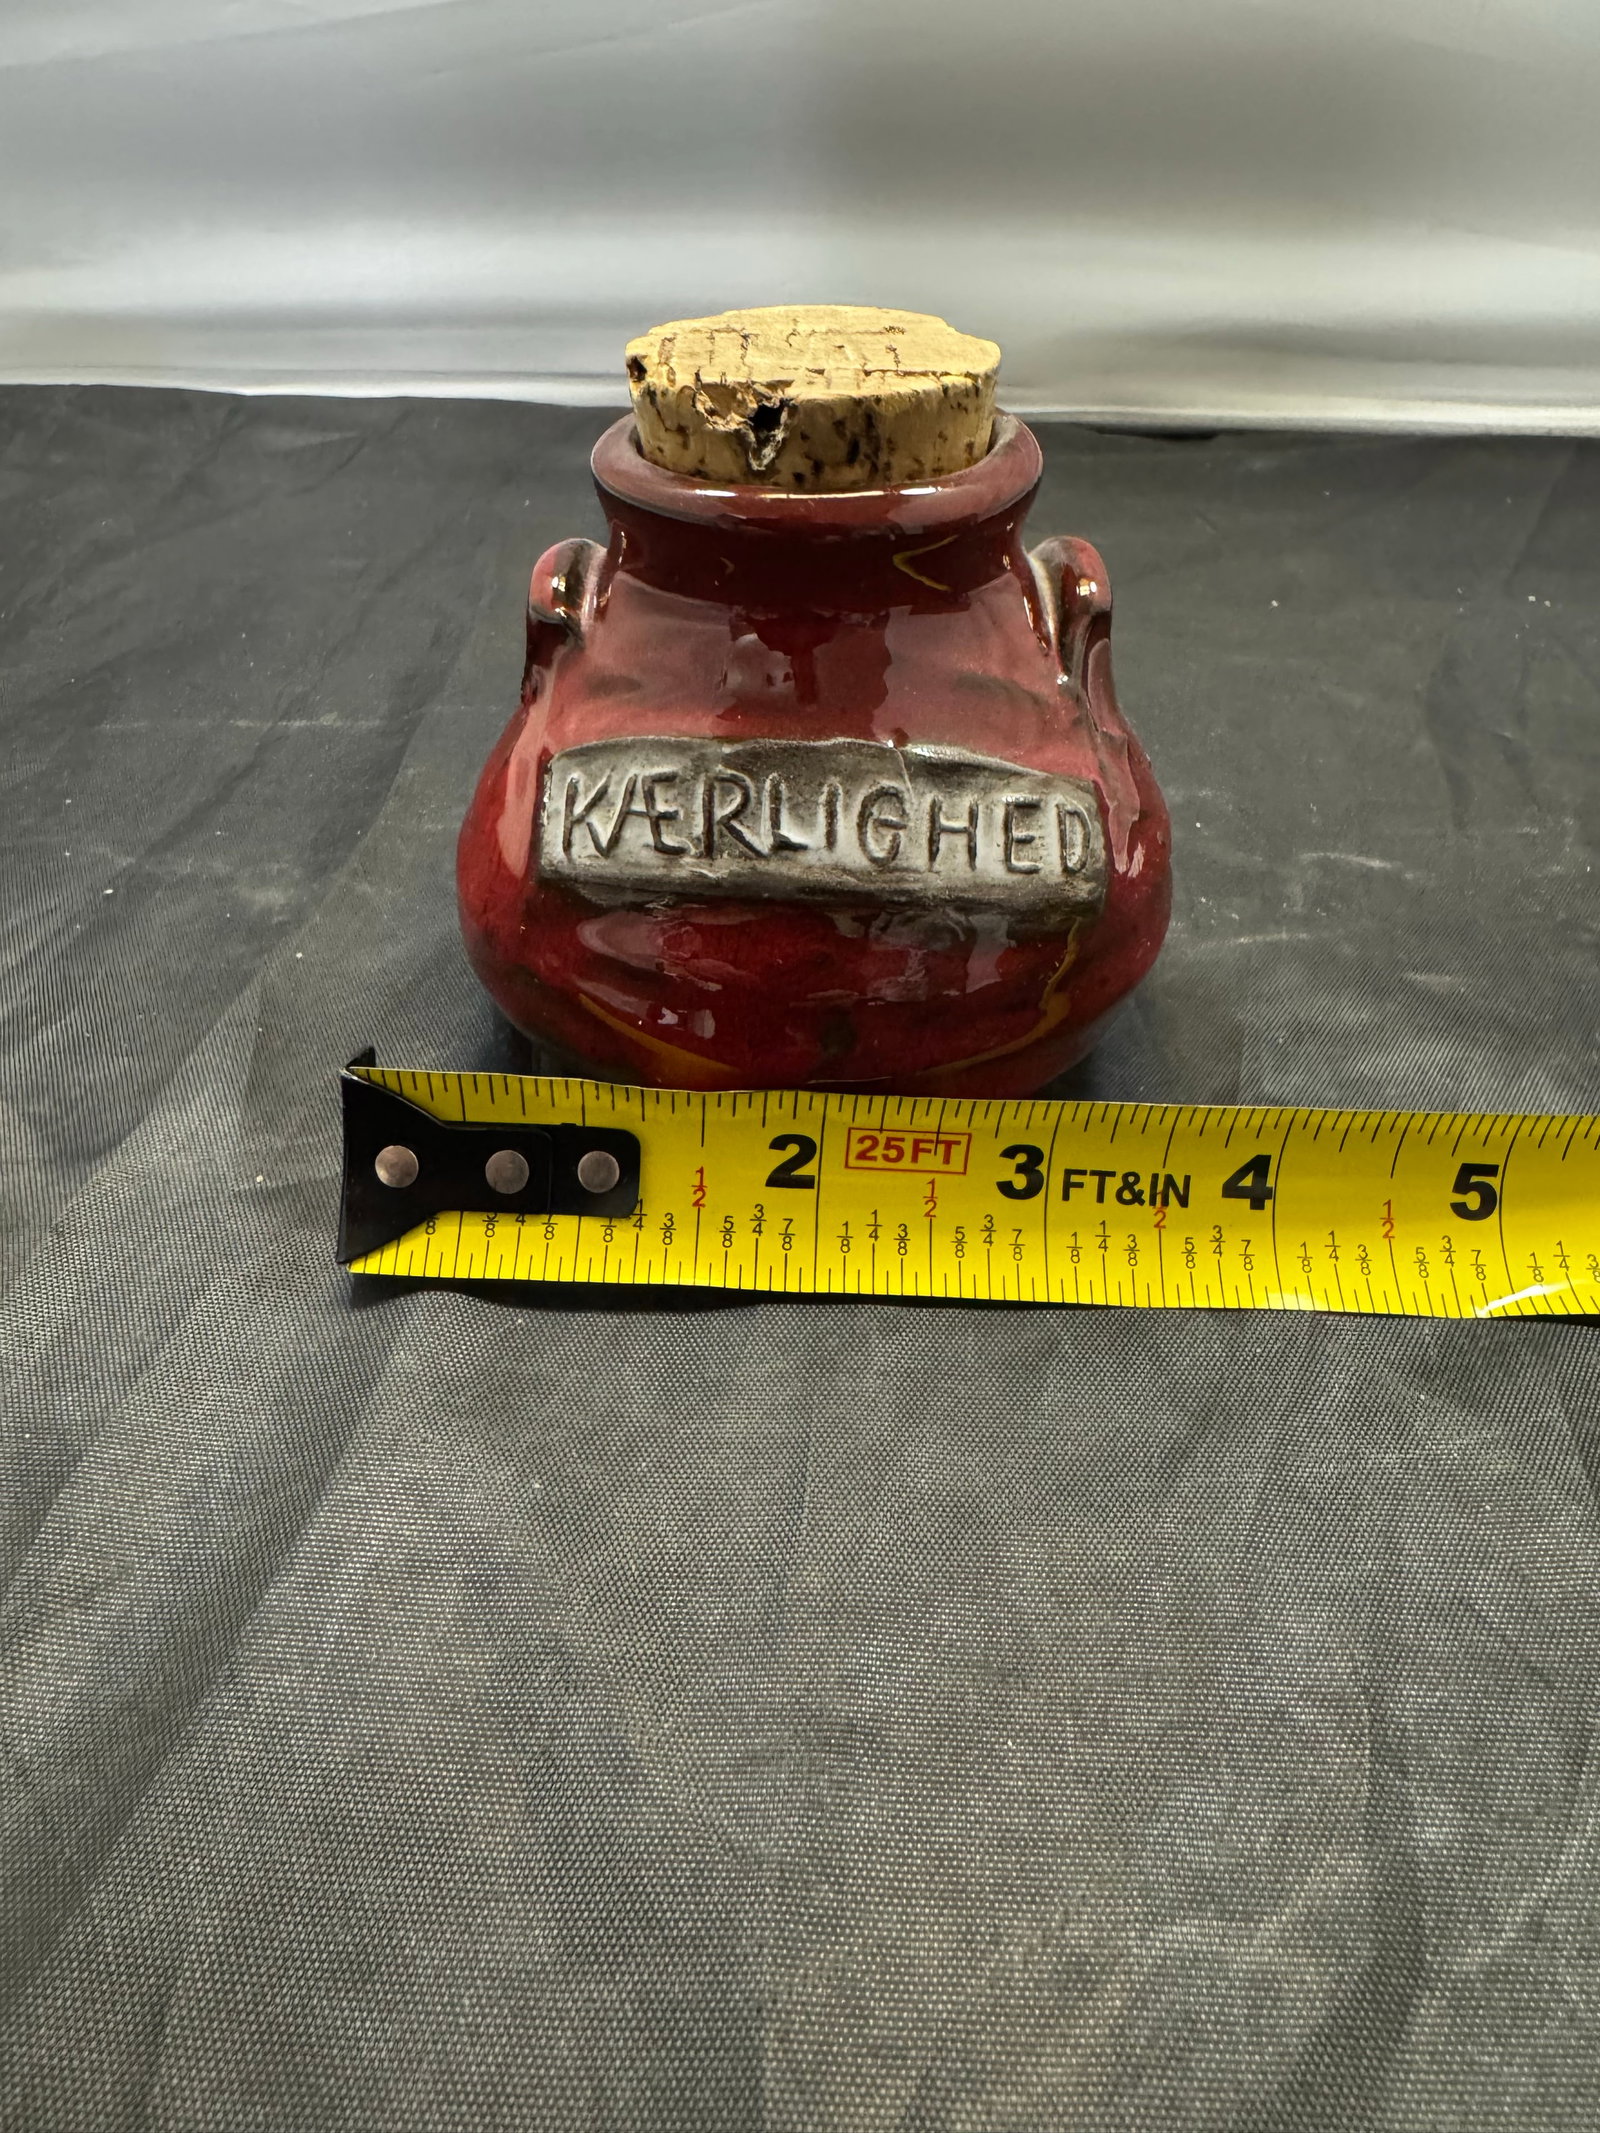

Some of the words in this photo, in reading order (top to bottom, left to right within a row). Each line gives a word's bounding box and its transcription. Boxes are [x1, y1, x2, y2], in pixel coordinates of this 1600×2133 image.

[561, 768, 1093, 875] KÆRLIGHED
[765, 1133, 818, 1189] 2
[855, 1134, 962, 1165] 25FT
[996, 1144, 1045, 1200] 3
[1222, 1154, 1273, 1210] 4
[1449, 1163, 1500, 1221] 5
